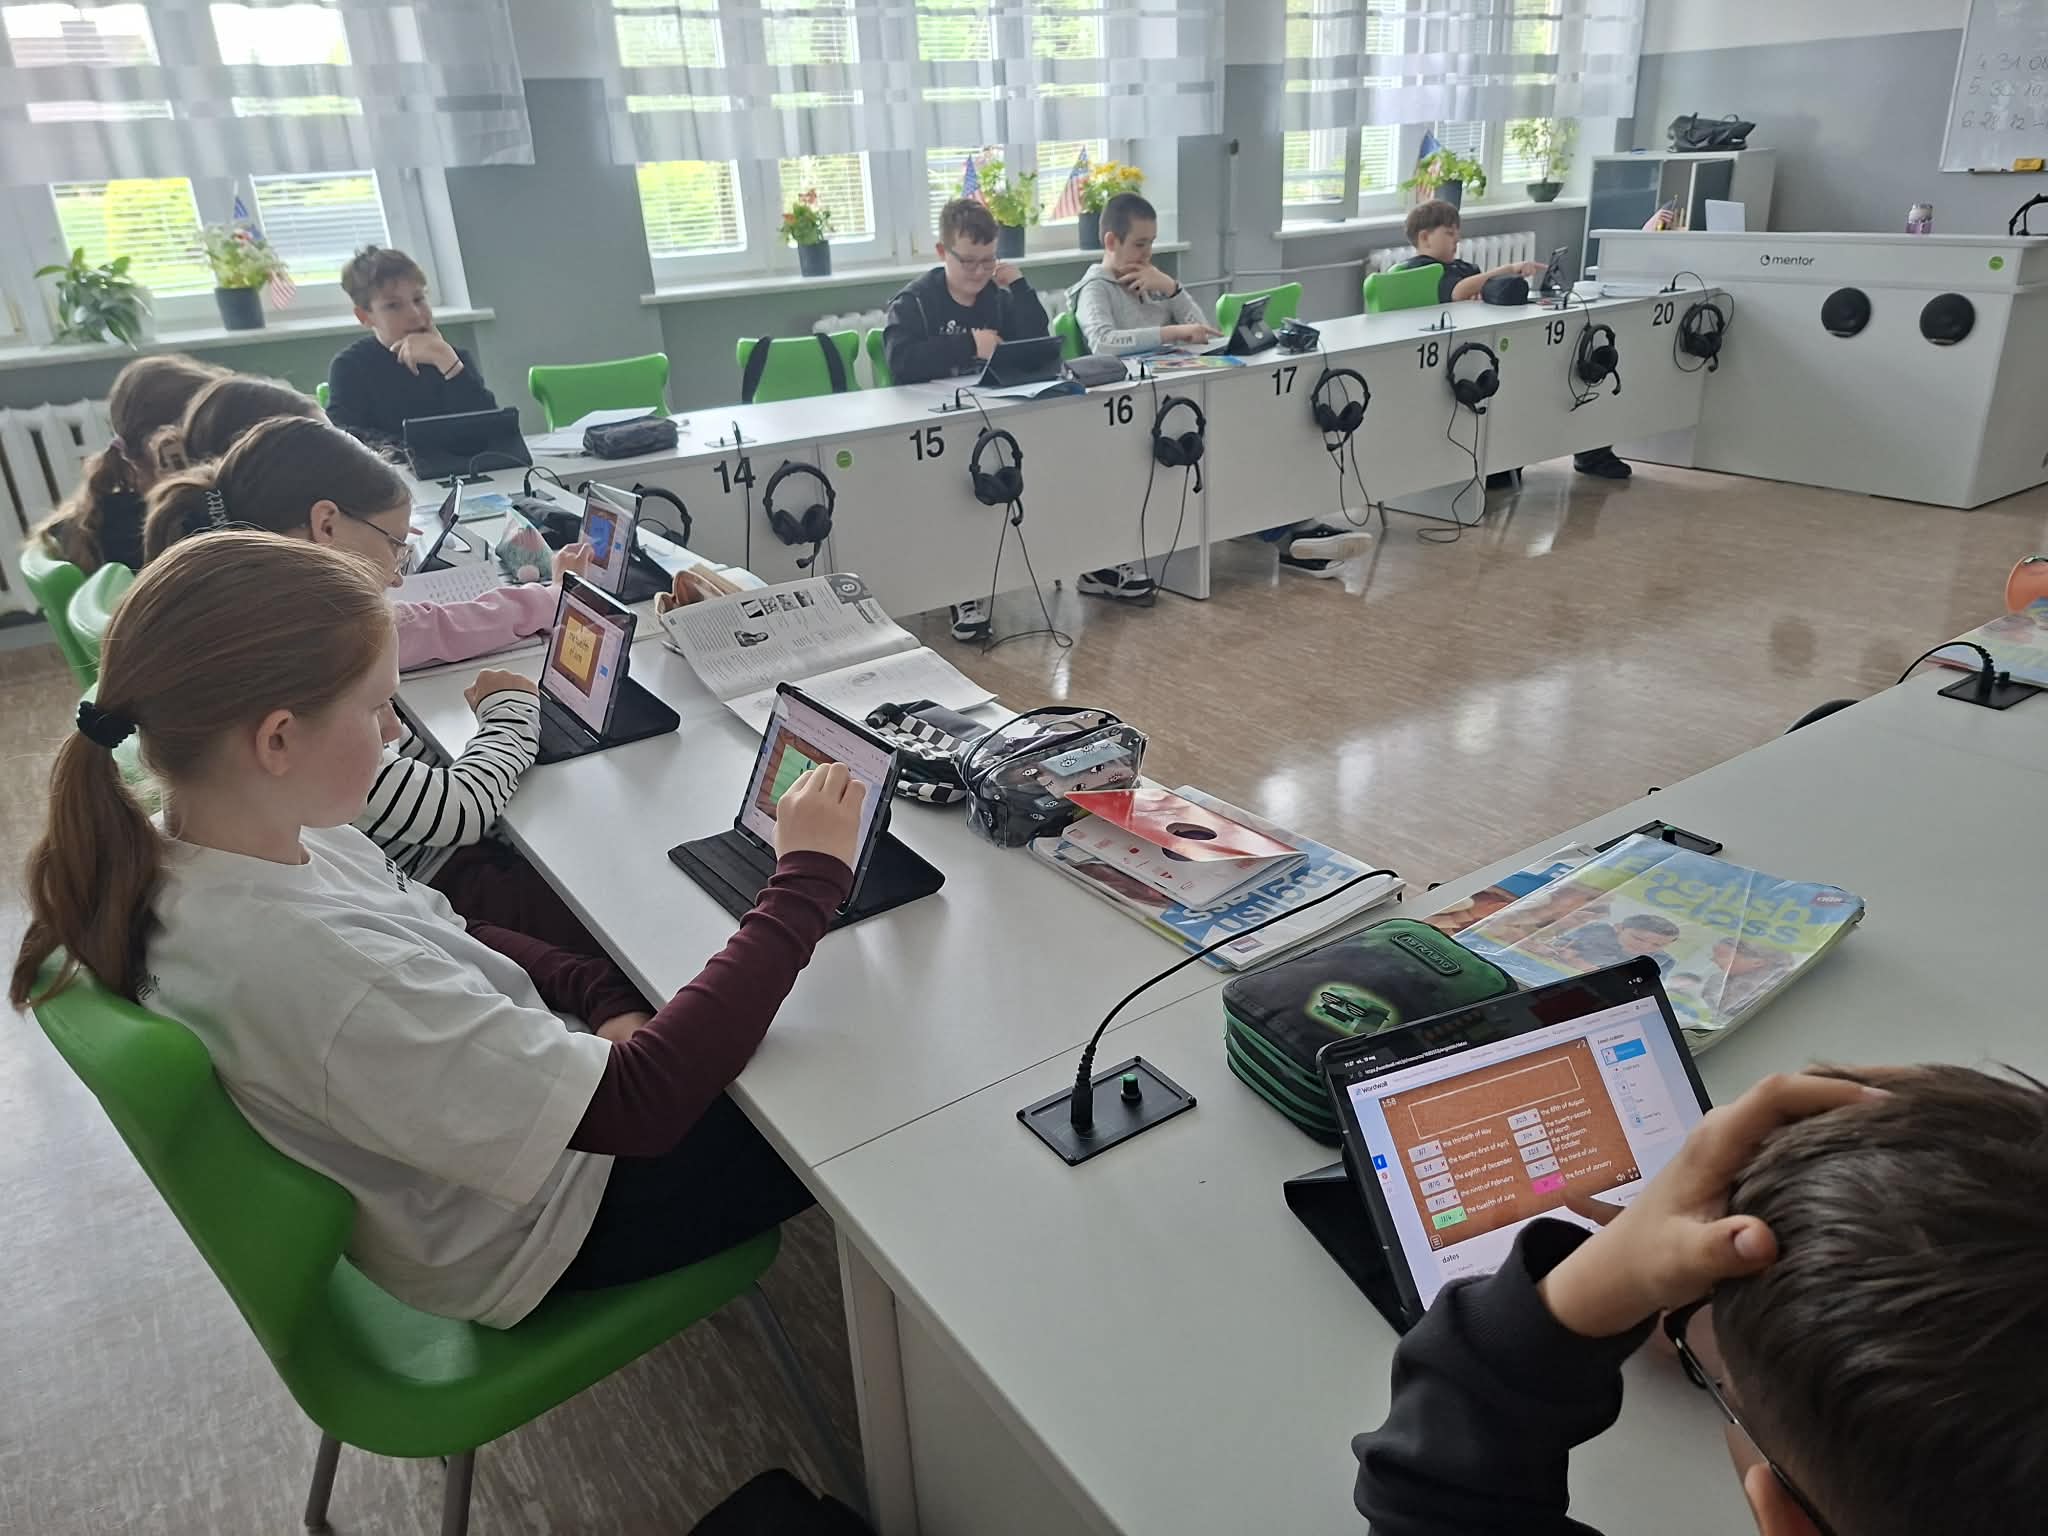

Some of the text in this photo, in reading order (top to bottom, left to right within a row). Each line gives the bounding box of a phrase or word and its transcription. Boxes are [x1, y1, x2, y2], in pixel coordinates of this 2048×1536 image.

[1771, 255, 1815, 266] mentor
[1652, 302, 1675, 326] 20
[1545, 320, 1565, 345] 19
[1416, 342, 1439, 369] 18
[1272, 366, 1298, 396] 17
[1103, 394, 1133, 426] 16
[909, 426, 945, 461] 15
[713, 457, 756, 494] 14
[1617, 855, 1812, 926] English
[1644, 884, 1801, 944] Class
[1362, 1081, 1389, 1094] Wordwall
[1442, 1253, 1460, 1264] dates
